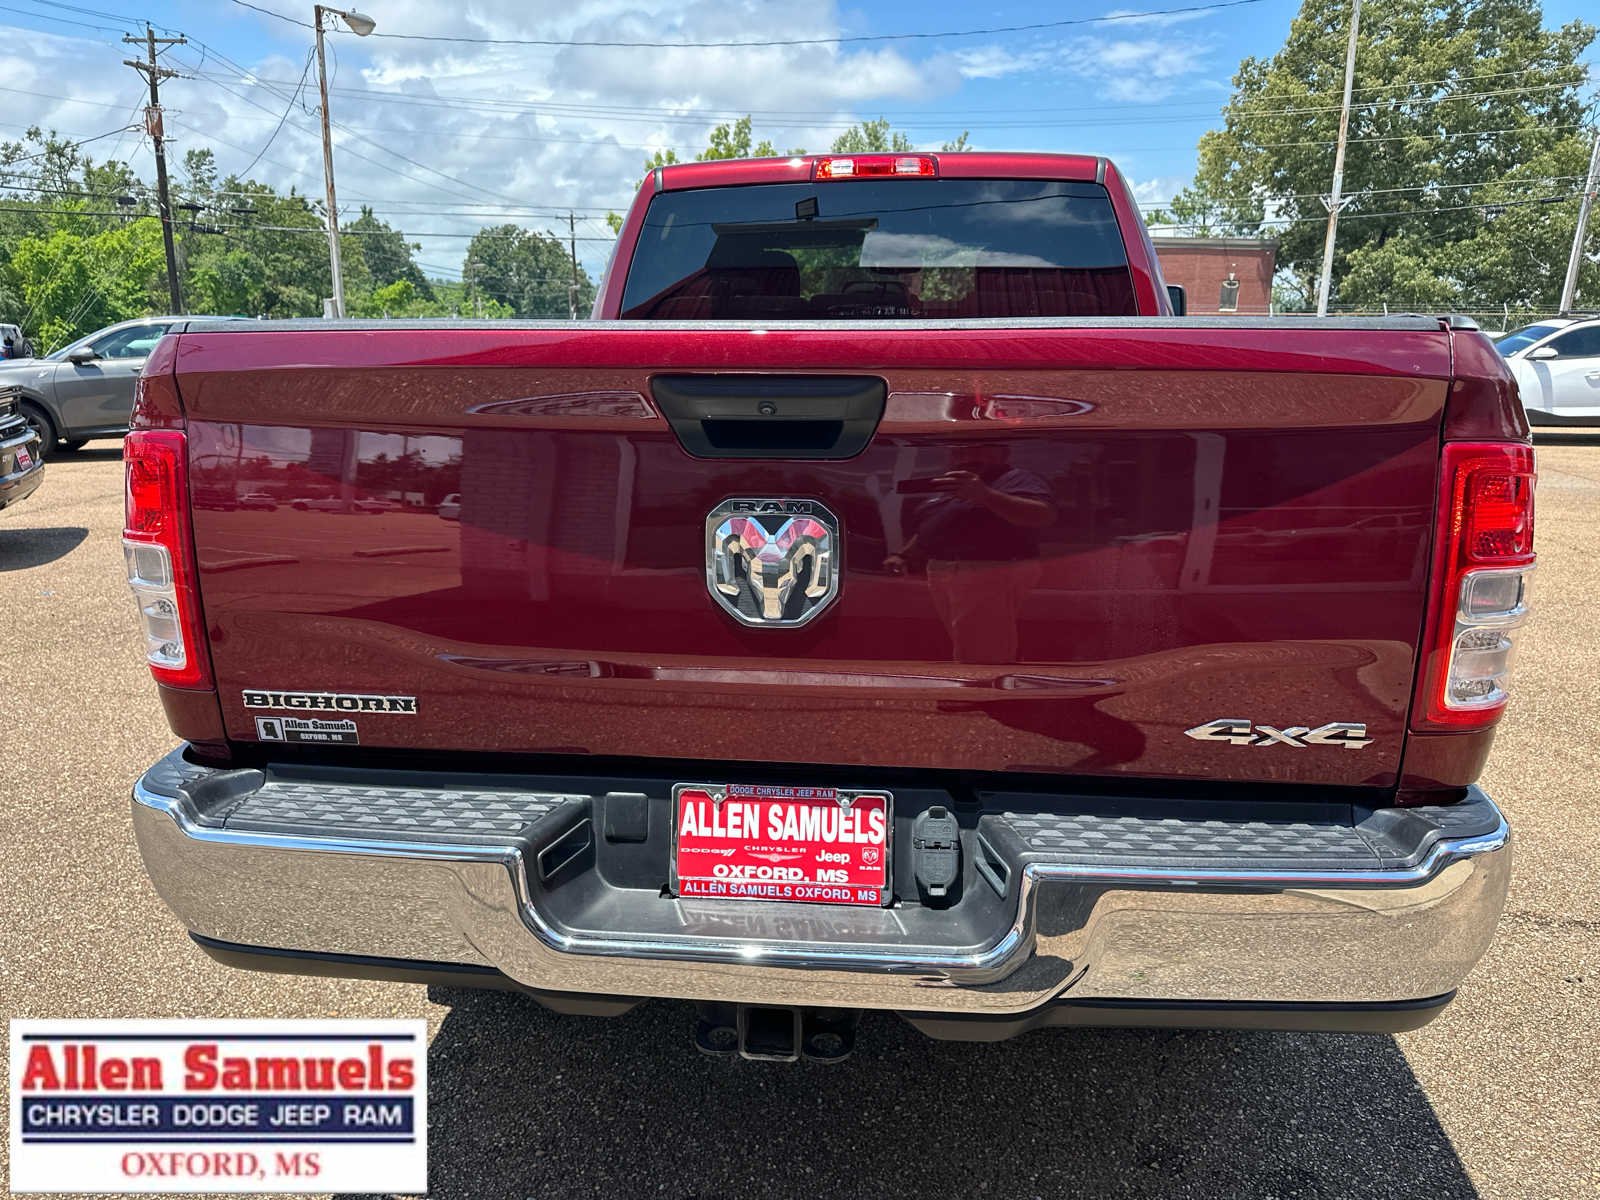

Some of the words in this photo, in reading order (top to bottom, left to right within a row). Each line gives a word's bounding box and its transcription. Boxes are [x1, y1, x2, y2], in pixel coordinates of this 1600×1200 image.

[732, 501, 812, 513] RAM
[242, 690, 416, 714] BIGHORN
[285, 719, 310, 729] Allen
[312, 720, 356, 731] Samuels
[730, 786, 754, 795] DODGE
[756, 787, 794, 797] CHRYSLER
[797, 788, 814, 798] JEEP
[816, 789, 834, 799] RAM
[681, 801, 760, 839] ALLEN
[767, 804, 885, 845] SAMUELS
[744, 845, 807, 853] CHRYSLER
[816, 849, 850, 865] Jeep
[713, 864, 810, 883] OXFORD,
[817, 868, 849, 883] MS
[684, 882, 727, 894] ALLEN
[729, 883, 793, 897] SAMUELS
[795, 886, 856, 902] OXFORD,
[858, 890, 877, 901] MS
